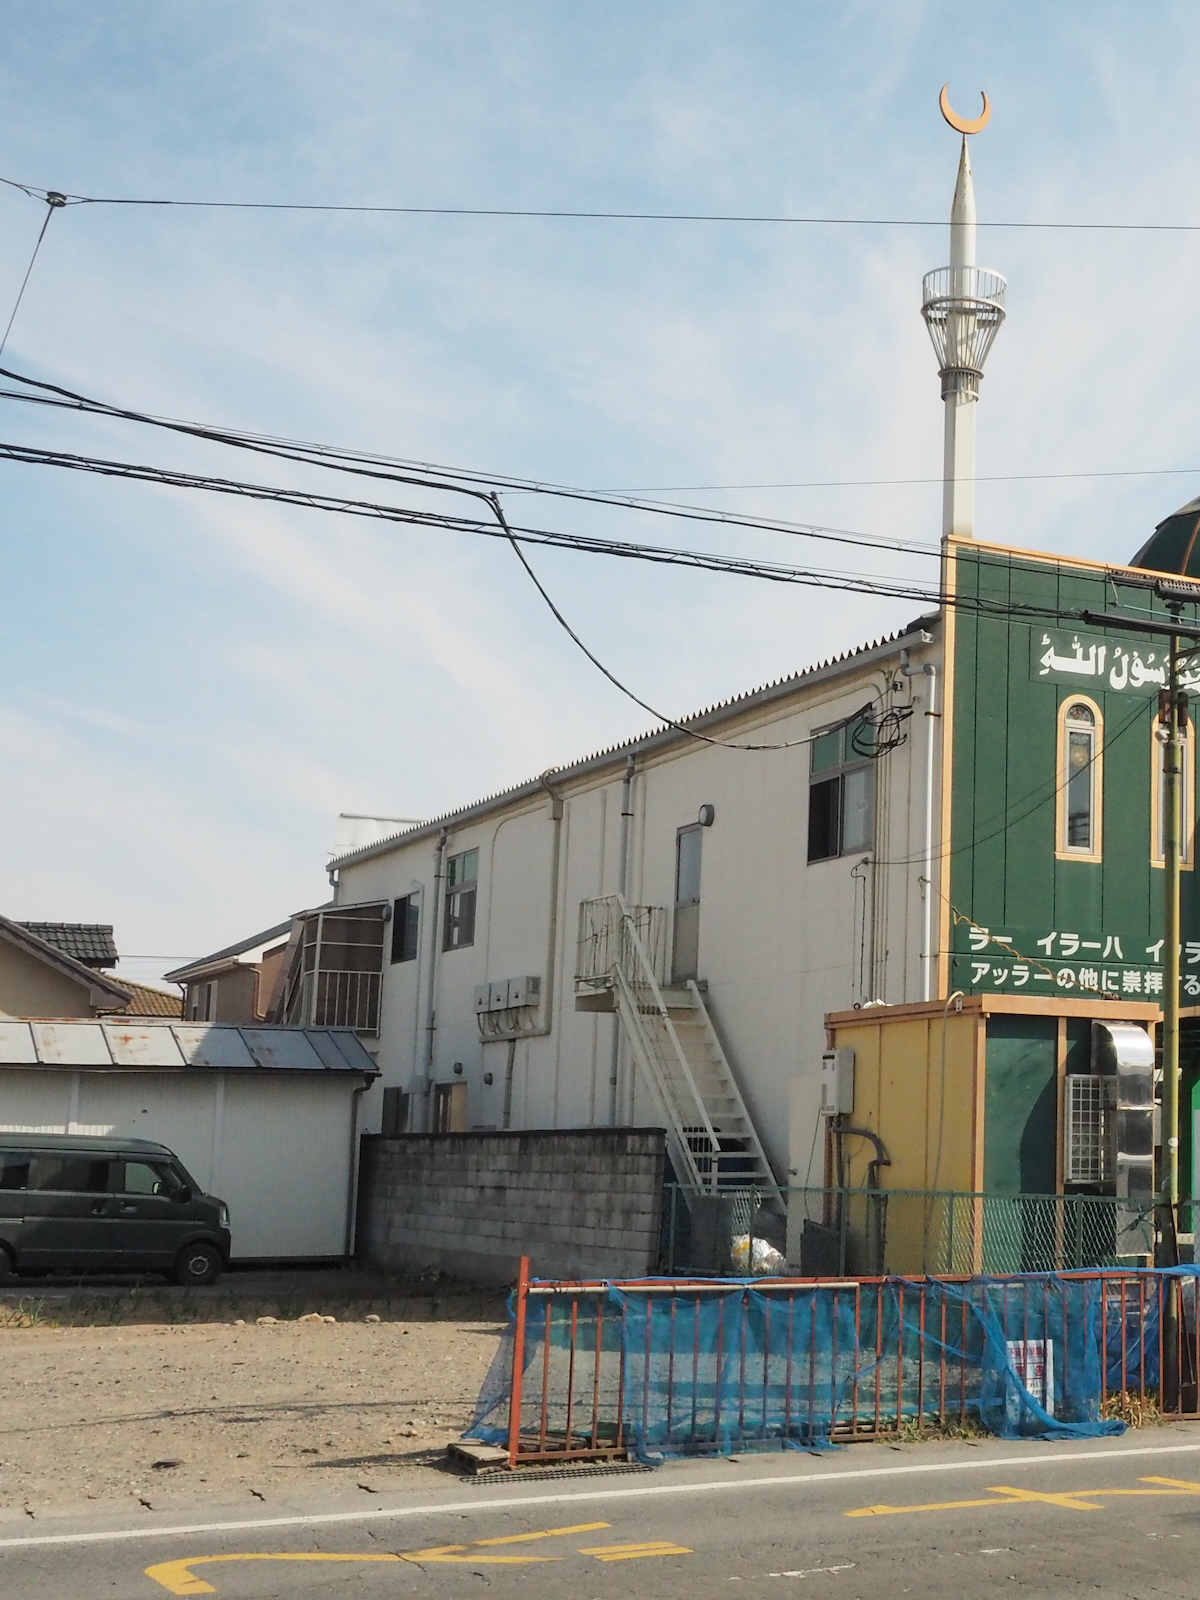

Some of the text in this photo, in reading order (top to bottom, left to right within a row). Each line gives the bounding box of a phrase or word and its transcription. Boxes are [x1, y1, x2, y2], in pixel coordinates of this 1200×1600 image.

[968, 926, 1013, 951] ラー
[1036, 931, 1124, 960] イラーハ
